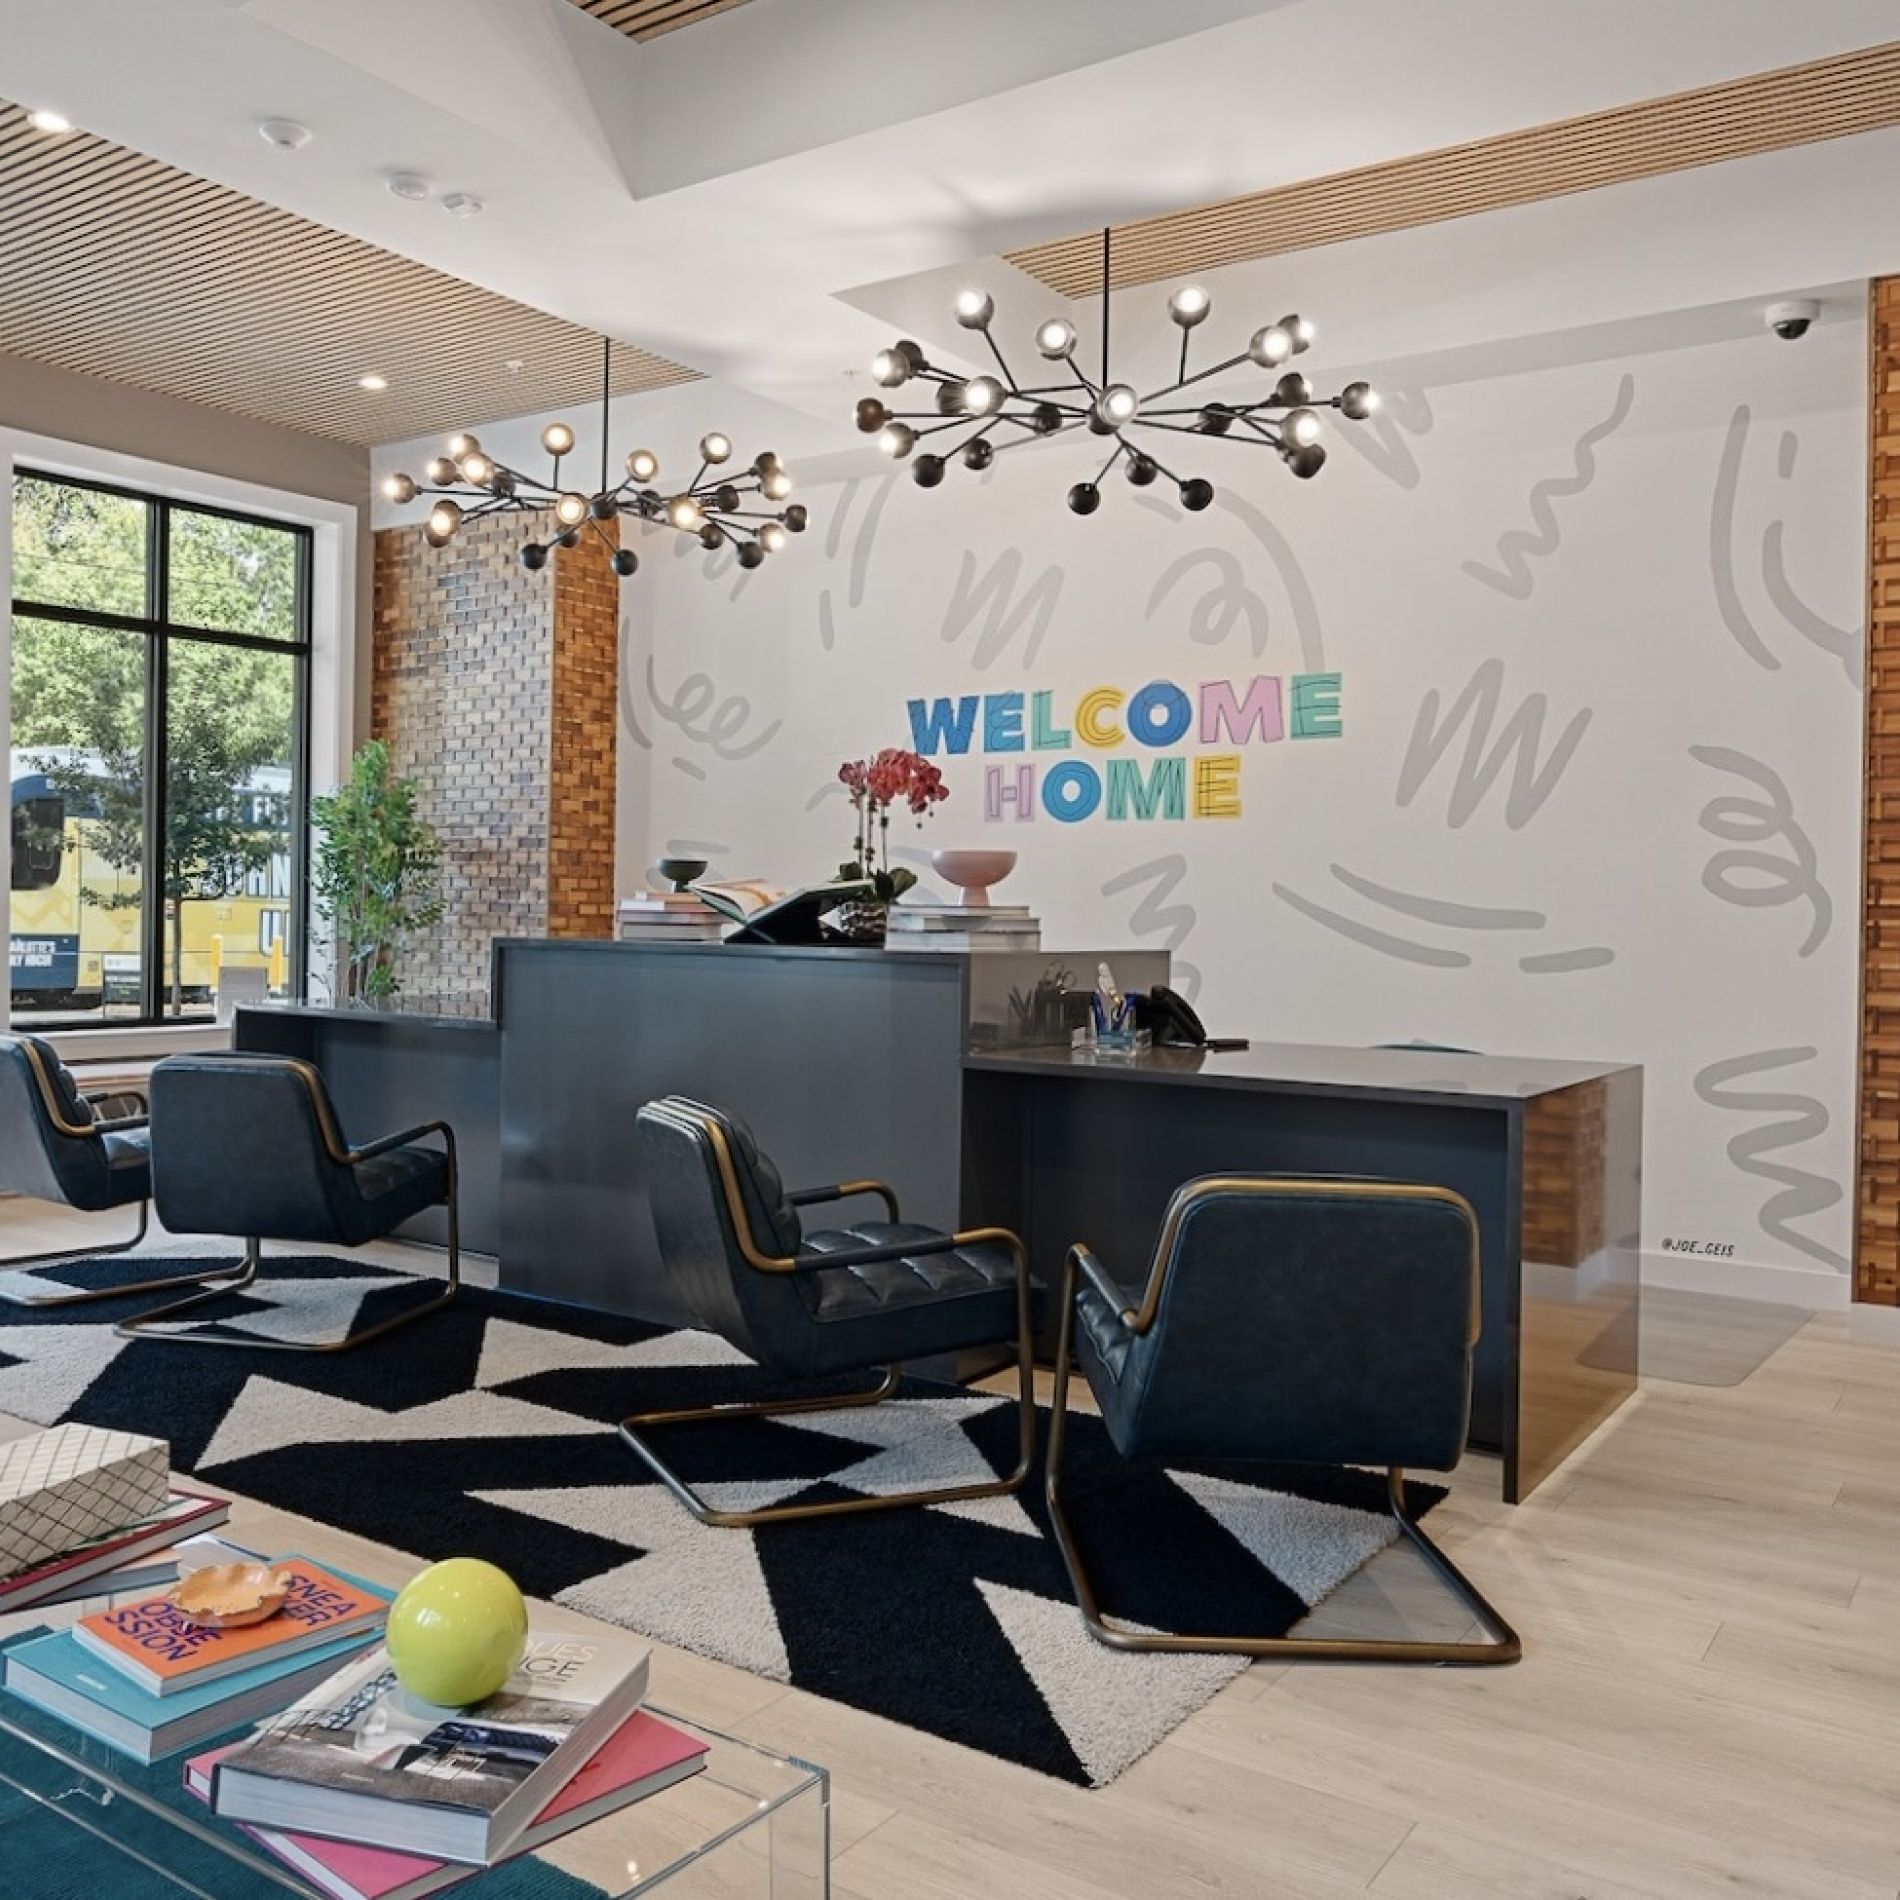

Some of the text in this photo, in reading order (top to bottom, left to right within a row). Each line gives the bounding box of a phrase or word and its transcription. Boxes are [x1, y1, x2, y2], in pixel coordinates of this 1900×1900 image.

[906, 672, 1343, 755] WELCOME
[984, 753, 1242, 823] HOME
[104, 1609, 199, 1661] SSION
